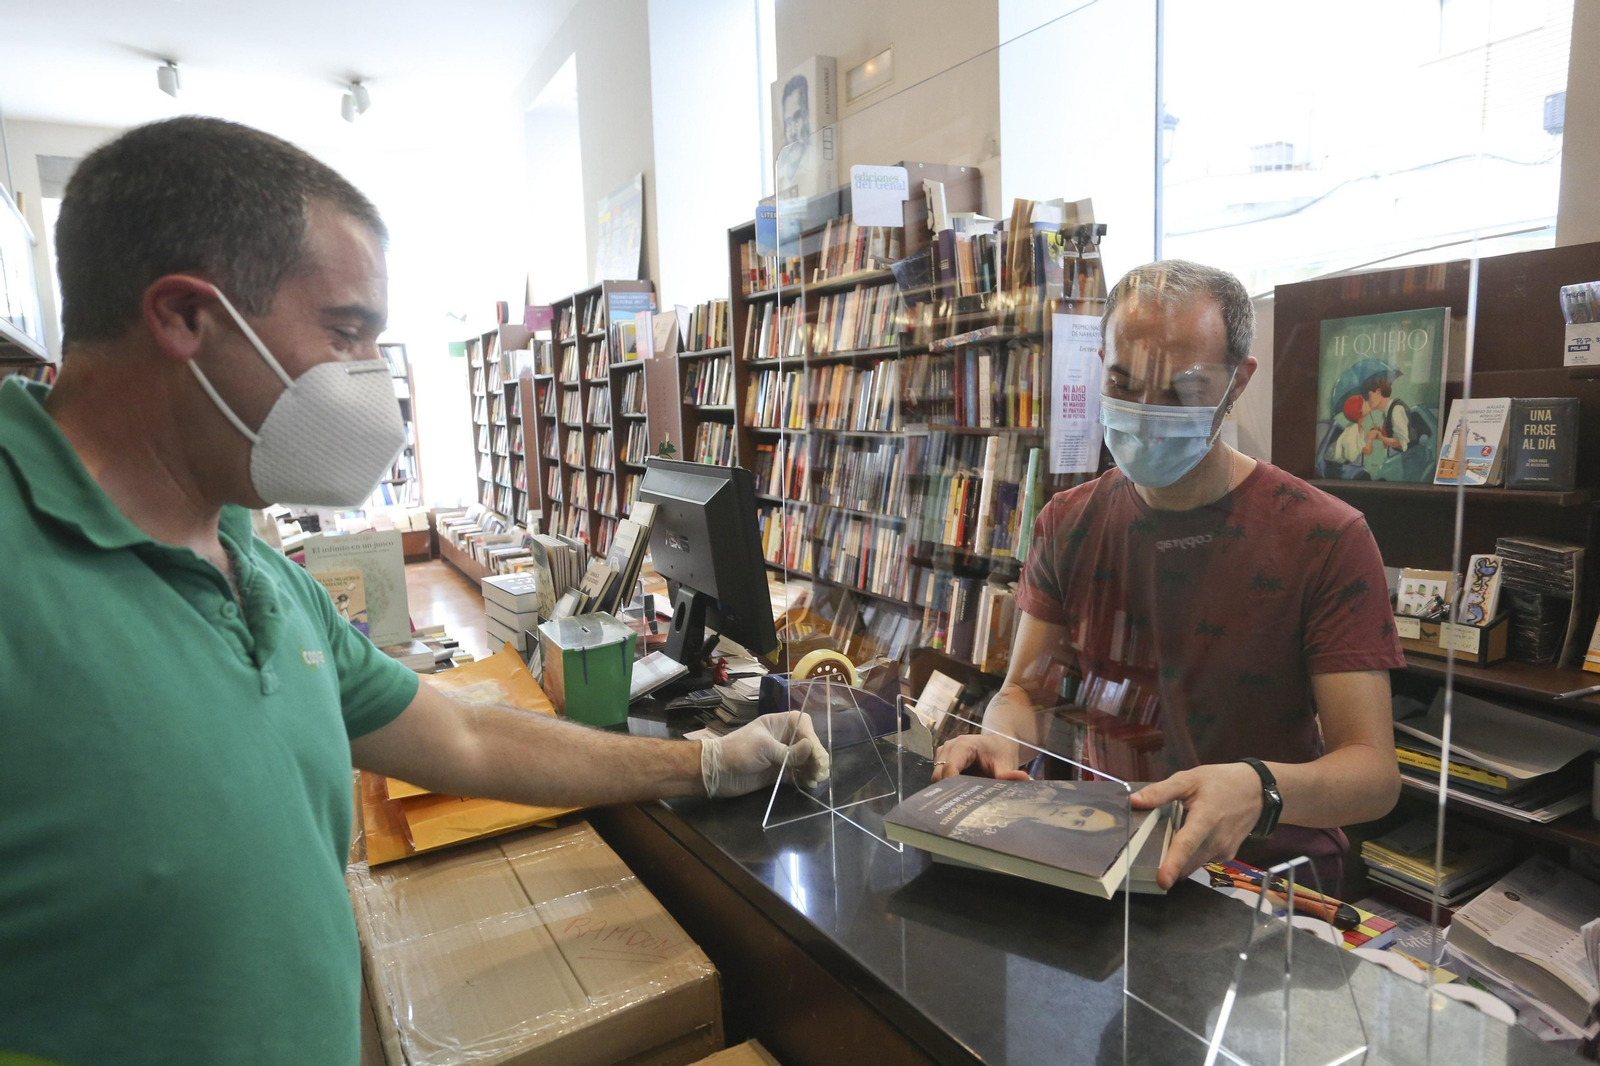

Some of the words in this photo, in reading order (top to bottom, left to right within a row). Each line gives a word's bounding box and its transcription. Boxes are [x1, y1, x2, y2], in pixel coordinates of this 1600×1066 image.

[854, 172, 899, 183] ediciones
[855, 180, 872, 189] del
[875, 180, 906, 191] Genal
[1072, 323, 1089, 331] PREMIO
[1334, 335, 1348, 356] TE
[1353, 329, 1428, 358] QUIERO
[1063, 385, 1070, 393] NI
[1071, 385, 1086, 393] AMO
[1063, 394, 1070, 402] NI
[1071, 394, 1086, 402] DIOS
[1529, 409, 1552, 421] UNA
[1523, 424, 1557, 436] FRASE
[1522, 438, 1536, 450] AL
[1538, 436, 1556, 450] DÍA
[322, 544, 350, 553] infinito
[373, 541, 394, 549] junco
